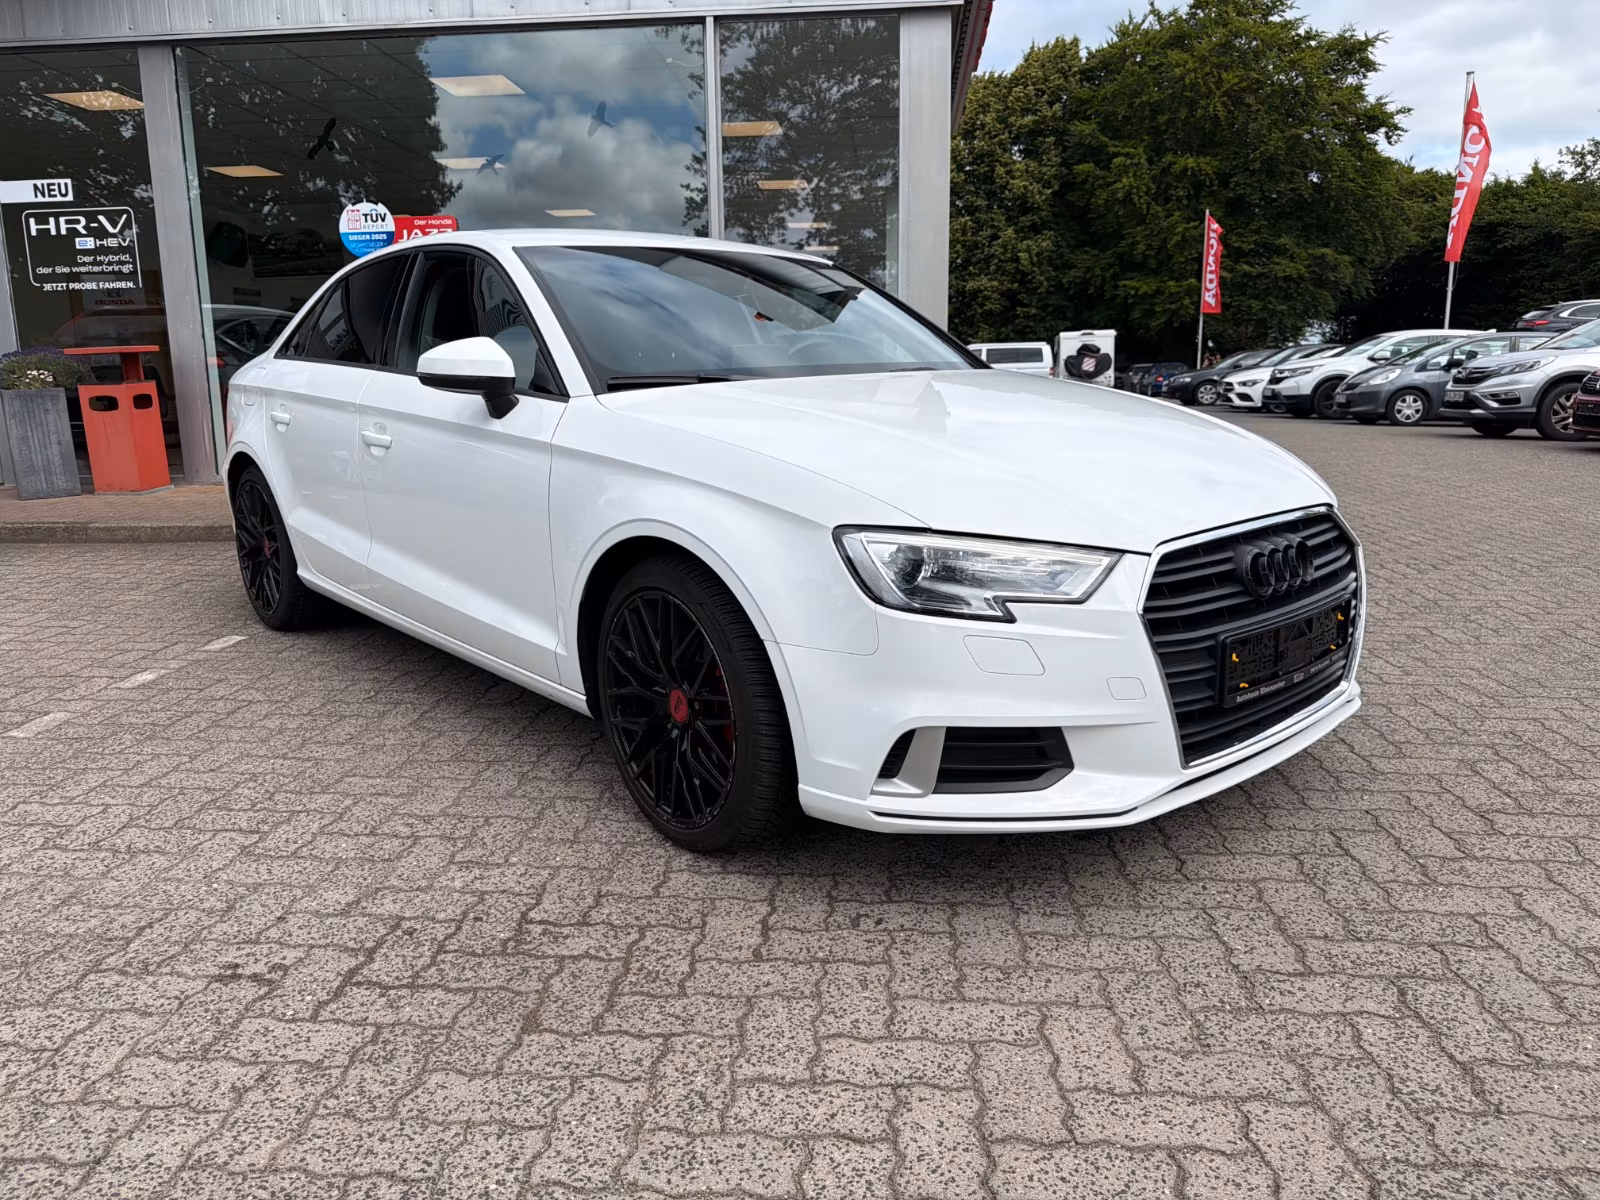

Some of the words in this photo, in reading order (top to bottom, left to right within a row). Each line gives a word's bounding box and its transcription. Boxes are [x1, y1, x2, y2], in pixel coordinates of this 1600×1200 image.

[32, 181, 69, 199] NEU
[362, 208, 387, 223] TÜV
[28, 213, 128, 236] HR-V
[76, 254, 95, 263] Der
[96, 253, 133, 264] Hybrid,
[36, 265, 53, 274] der
[54, 264, 71, 274] Sie
[42, 283, 67, 291] JETZT
[68, 282, 98, 290] PROBE
[99, 281, 136, 290] FAHREN.
